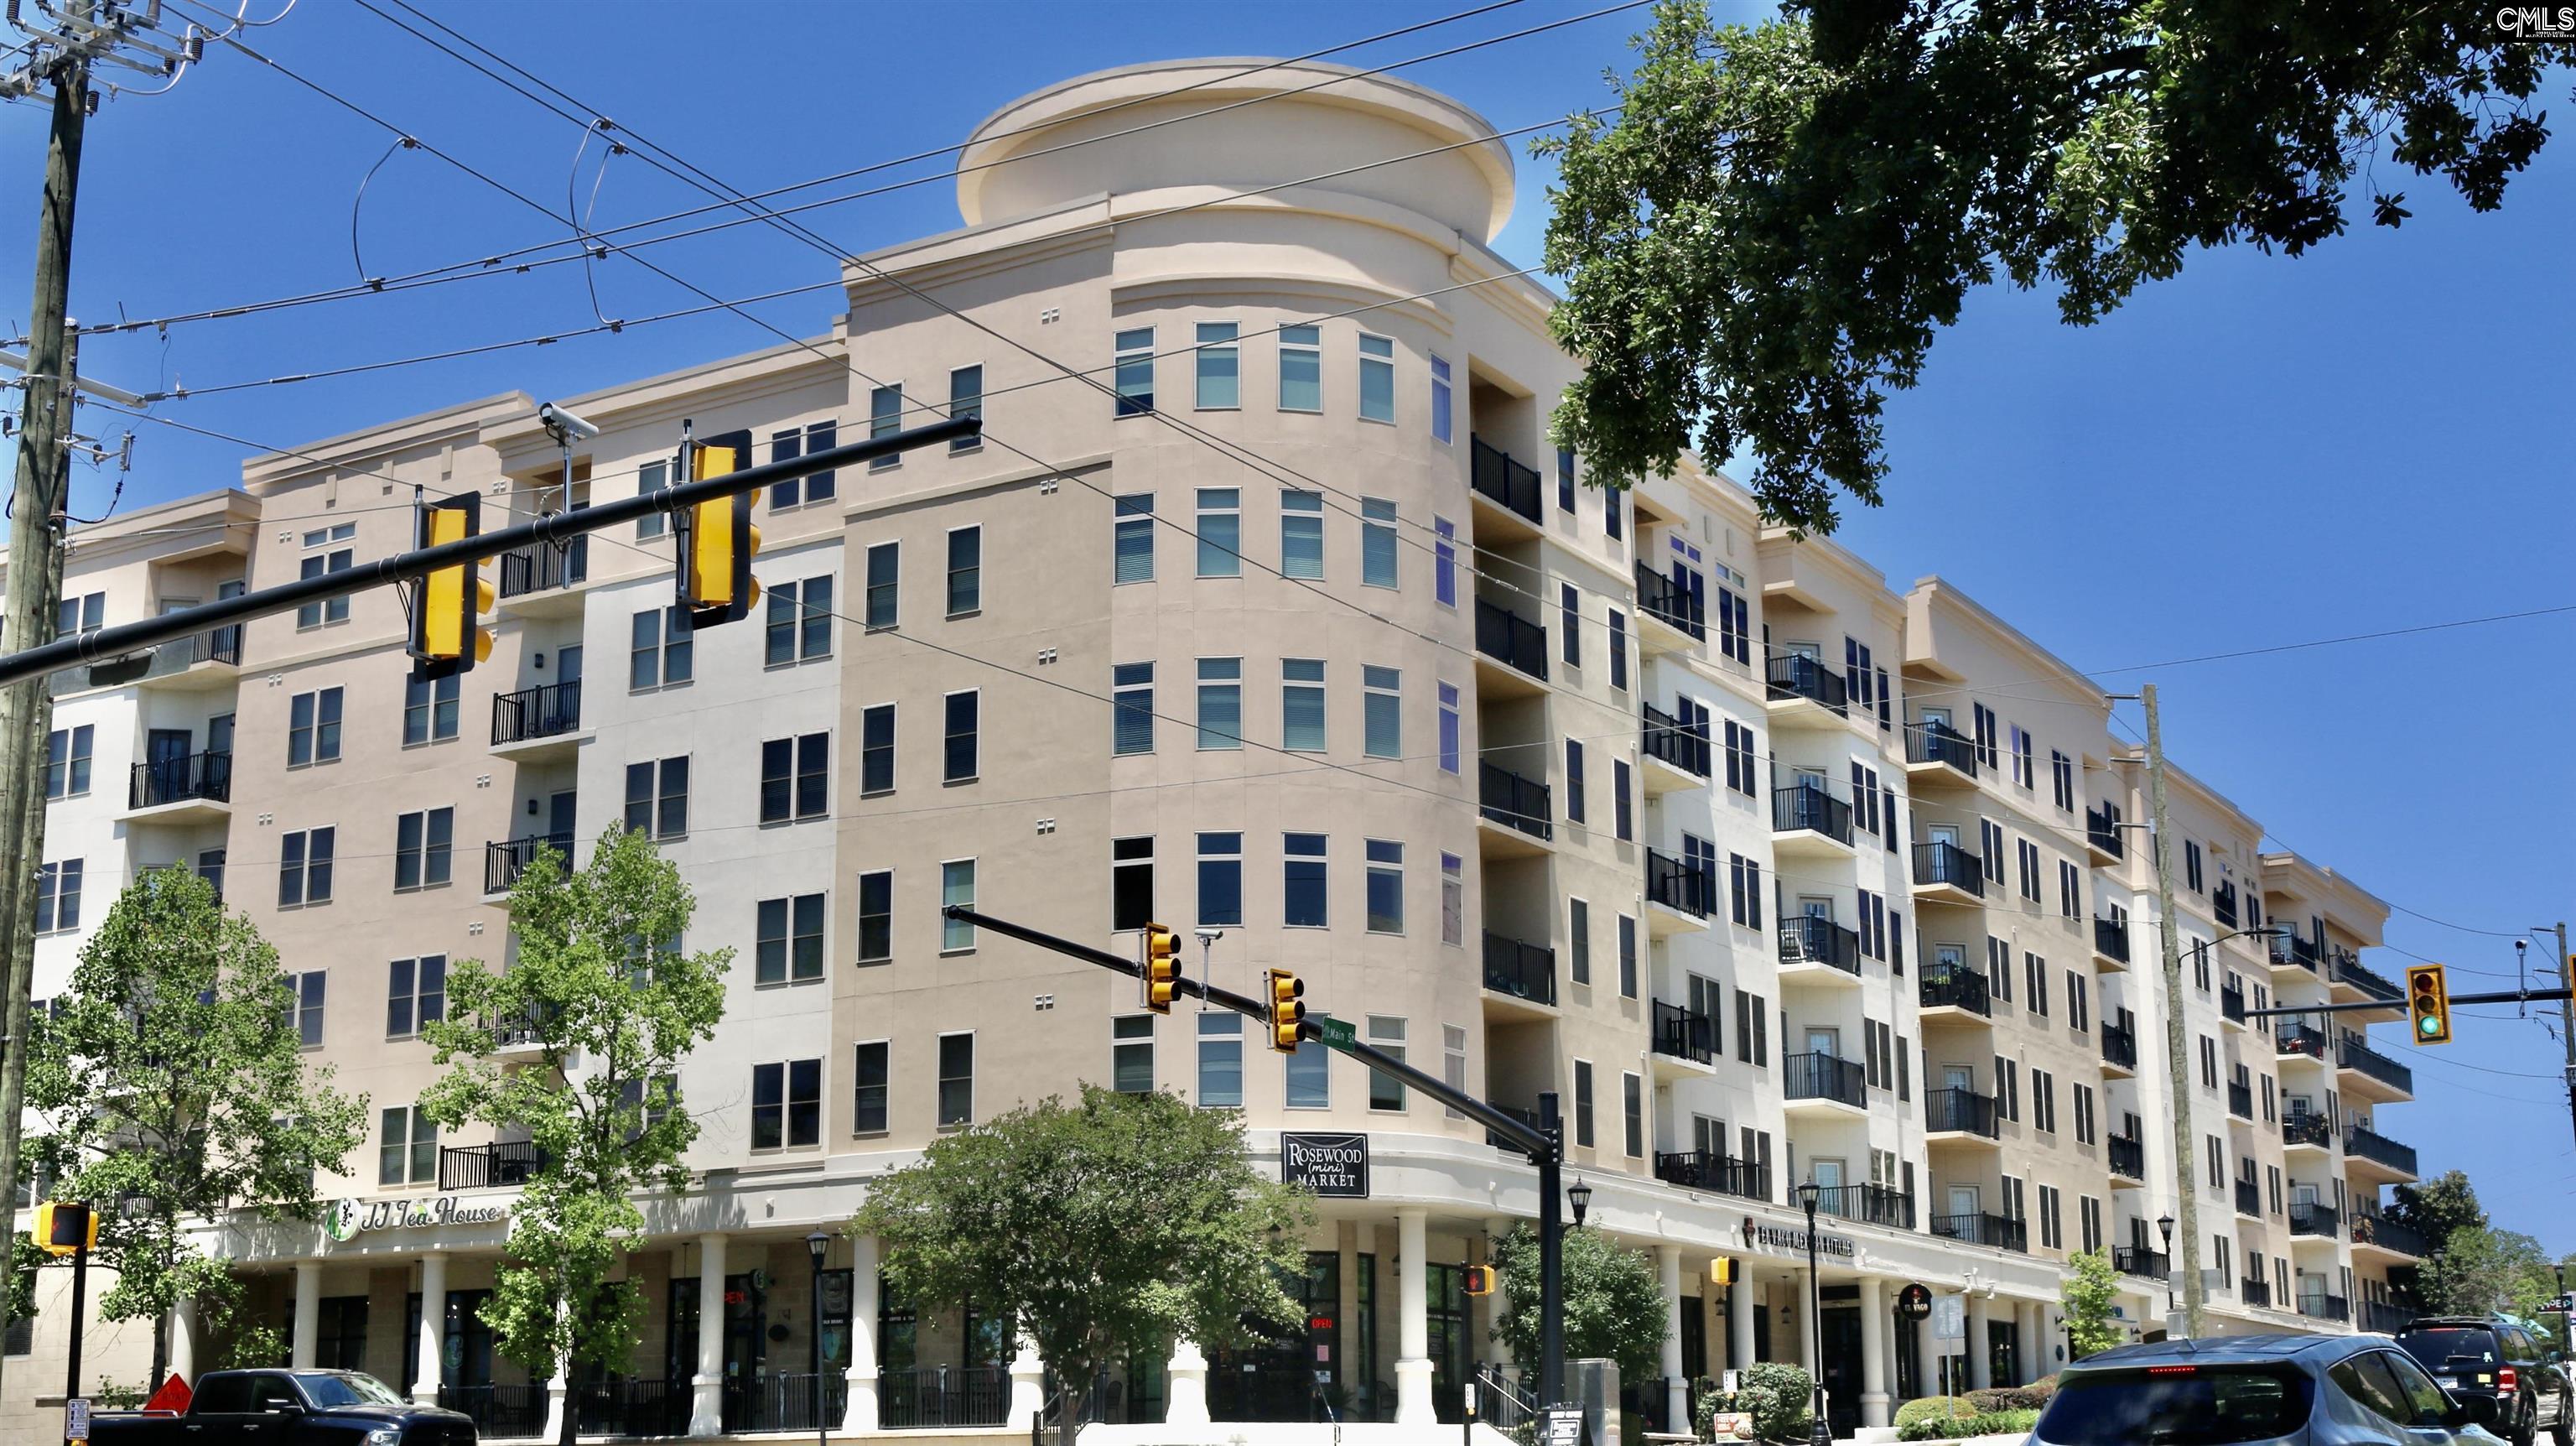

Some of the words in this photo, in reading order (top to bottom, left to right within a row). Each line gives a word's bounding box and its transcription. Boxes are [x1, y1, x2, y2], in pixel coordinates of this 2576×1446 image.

[1330, 1027, 1344, 1042] Main
[1348, 1032, 1354, 1043] St
[1289, 1144, 1362, 1166] ROSEWOOD
[1308, 1163, 1344, 1174] (mini)
[1297, 1174, 1355, 1186] MARKET
[361, 1204, 390, 1230] JJ
[395, 1200, 428, 1228] Tea
[435, 1197, 497, 1225] House
[1793, 1231, 1825, 1253] MEXAN
[1826, 1236, 1854, 1256] KITCHEN
[1311, 1318, 1332, 1329] OPEN
